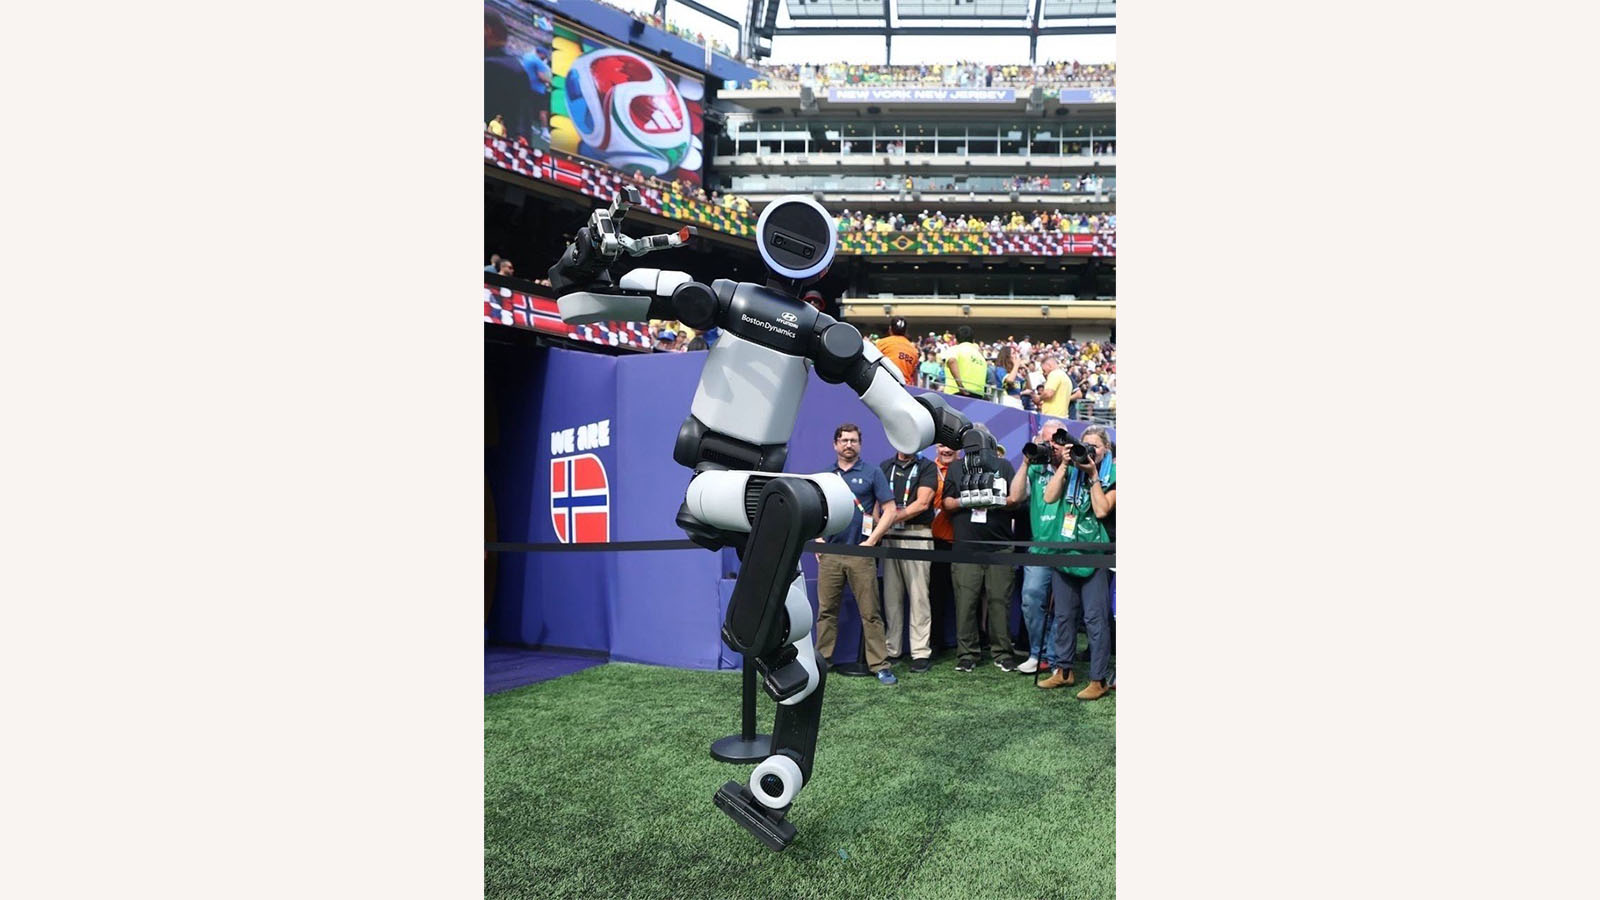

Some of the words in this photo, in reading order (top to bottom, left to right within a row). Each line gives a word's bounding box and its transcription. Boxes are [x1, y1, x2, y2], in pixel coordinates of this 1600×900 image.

[837, 90, 870, 99] NEW
[872, 90, 911, 99] YORK
[915, 90, 948, 99] NEW
[950, 90, 1006, 99] JERSEY
[551, 428, 575, 455] WE
[577, 419, 610, 451] ARE
